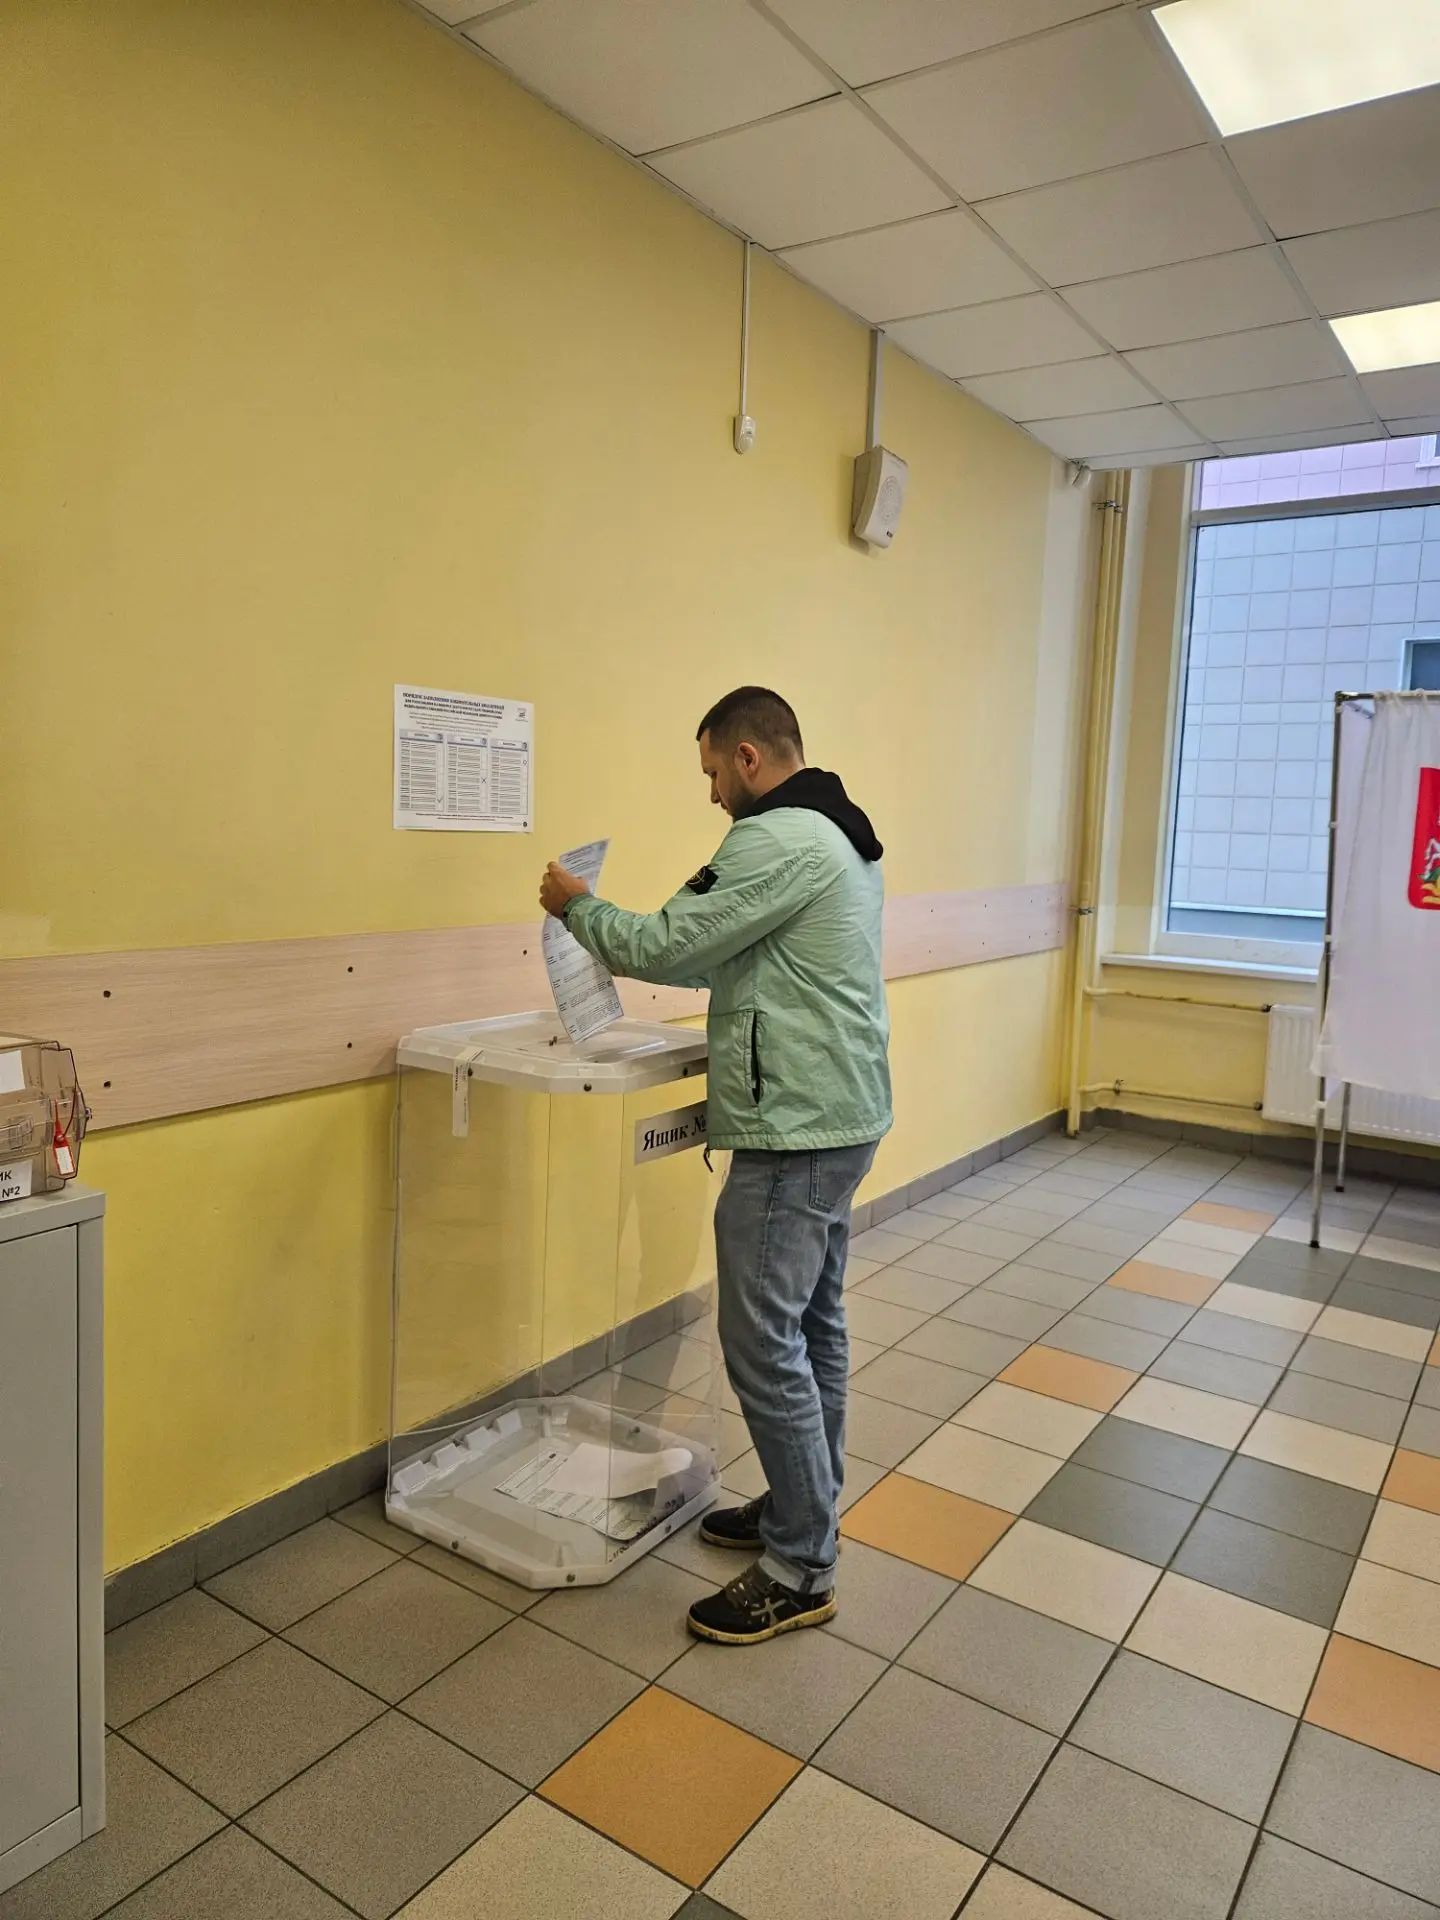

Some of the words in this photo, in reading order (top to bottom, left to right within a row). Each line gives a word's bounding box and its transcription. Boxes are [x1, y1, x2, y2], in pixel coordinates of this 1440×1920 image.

[642, 1124, 689, 1151] Ящик
[691, 1114, 707, 1136] №
[2, 1186, 20, 1198] №2
